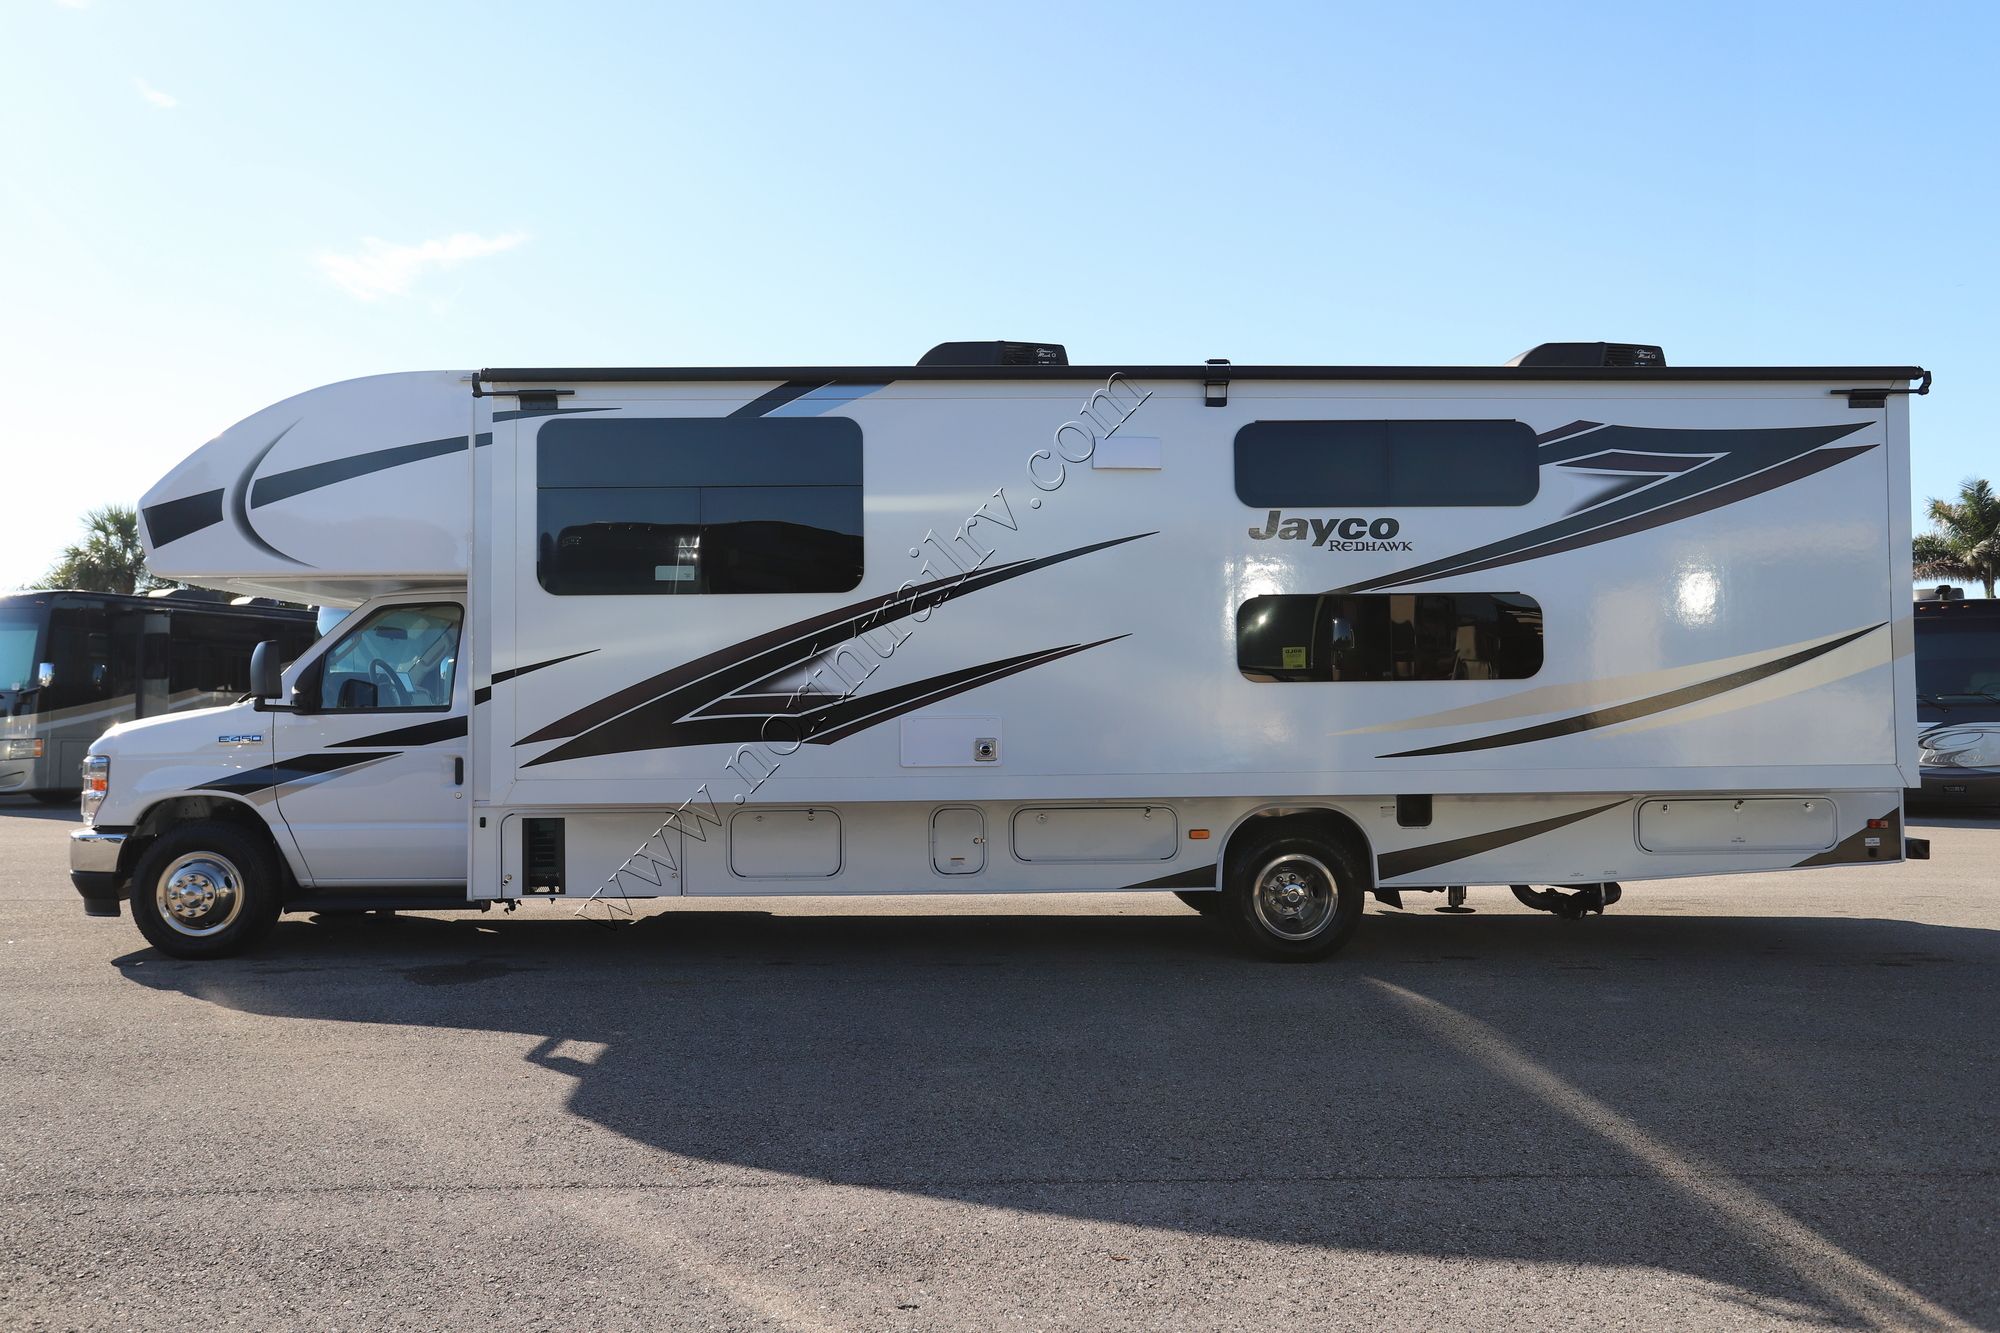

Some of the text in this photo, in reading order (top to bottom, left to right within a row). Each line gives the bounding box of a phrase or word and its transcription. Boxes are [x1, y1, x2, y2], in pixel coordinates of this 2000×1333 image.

[1248, 510, 1400, 546] Jayco
[1328, 540, 1413, 552] REDHAWK
[218, 735, 262, 743] E450
